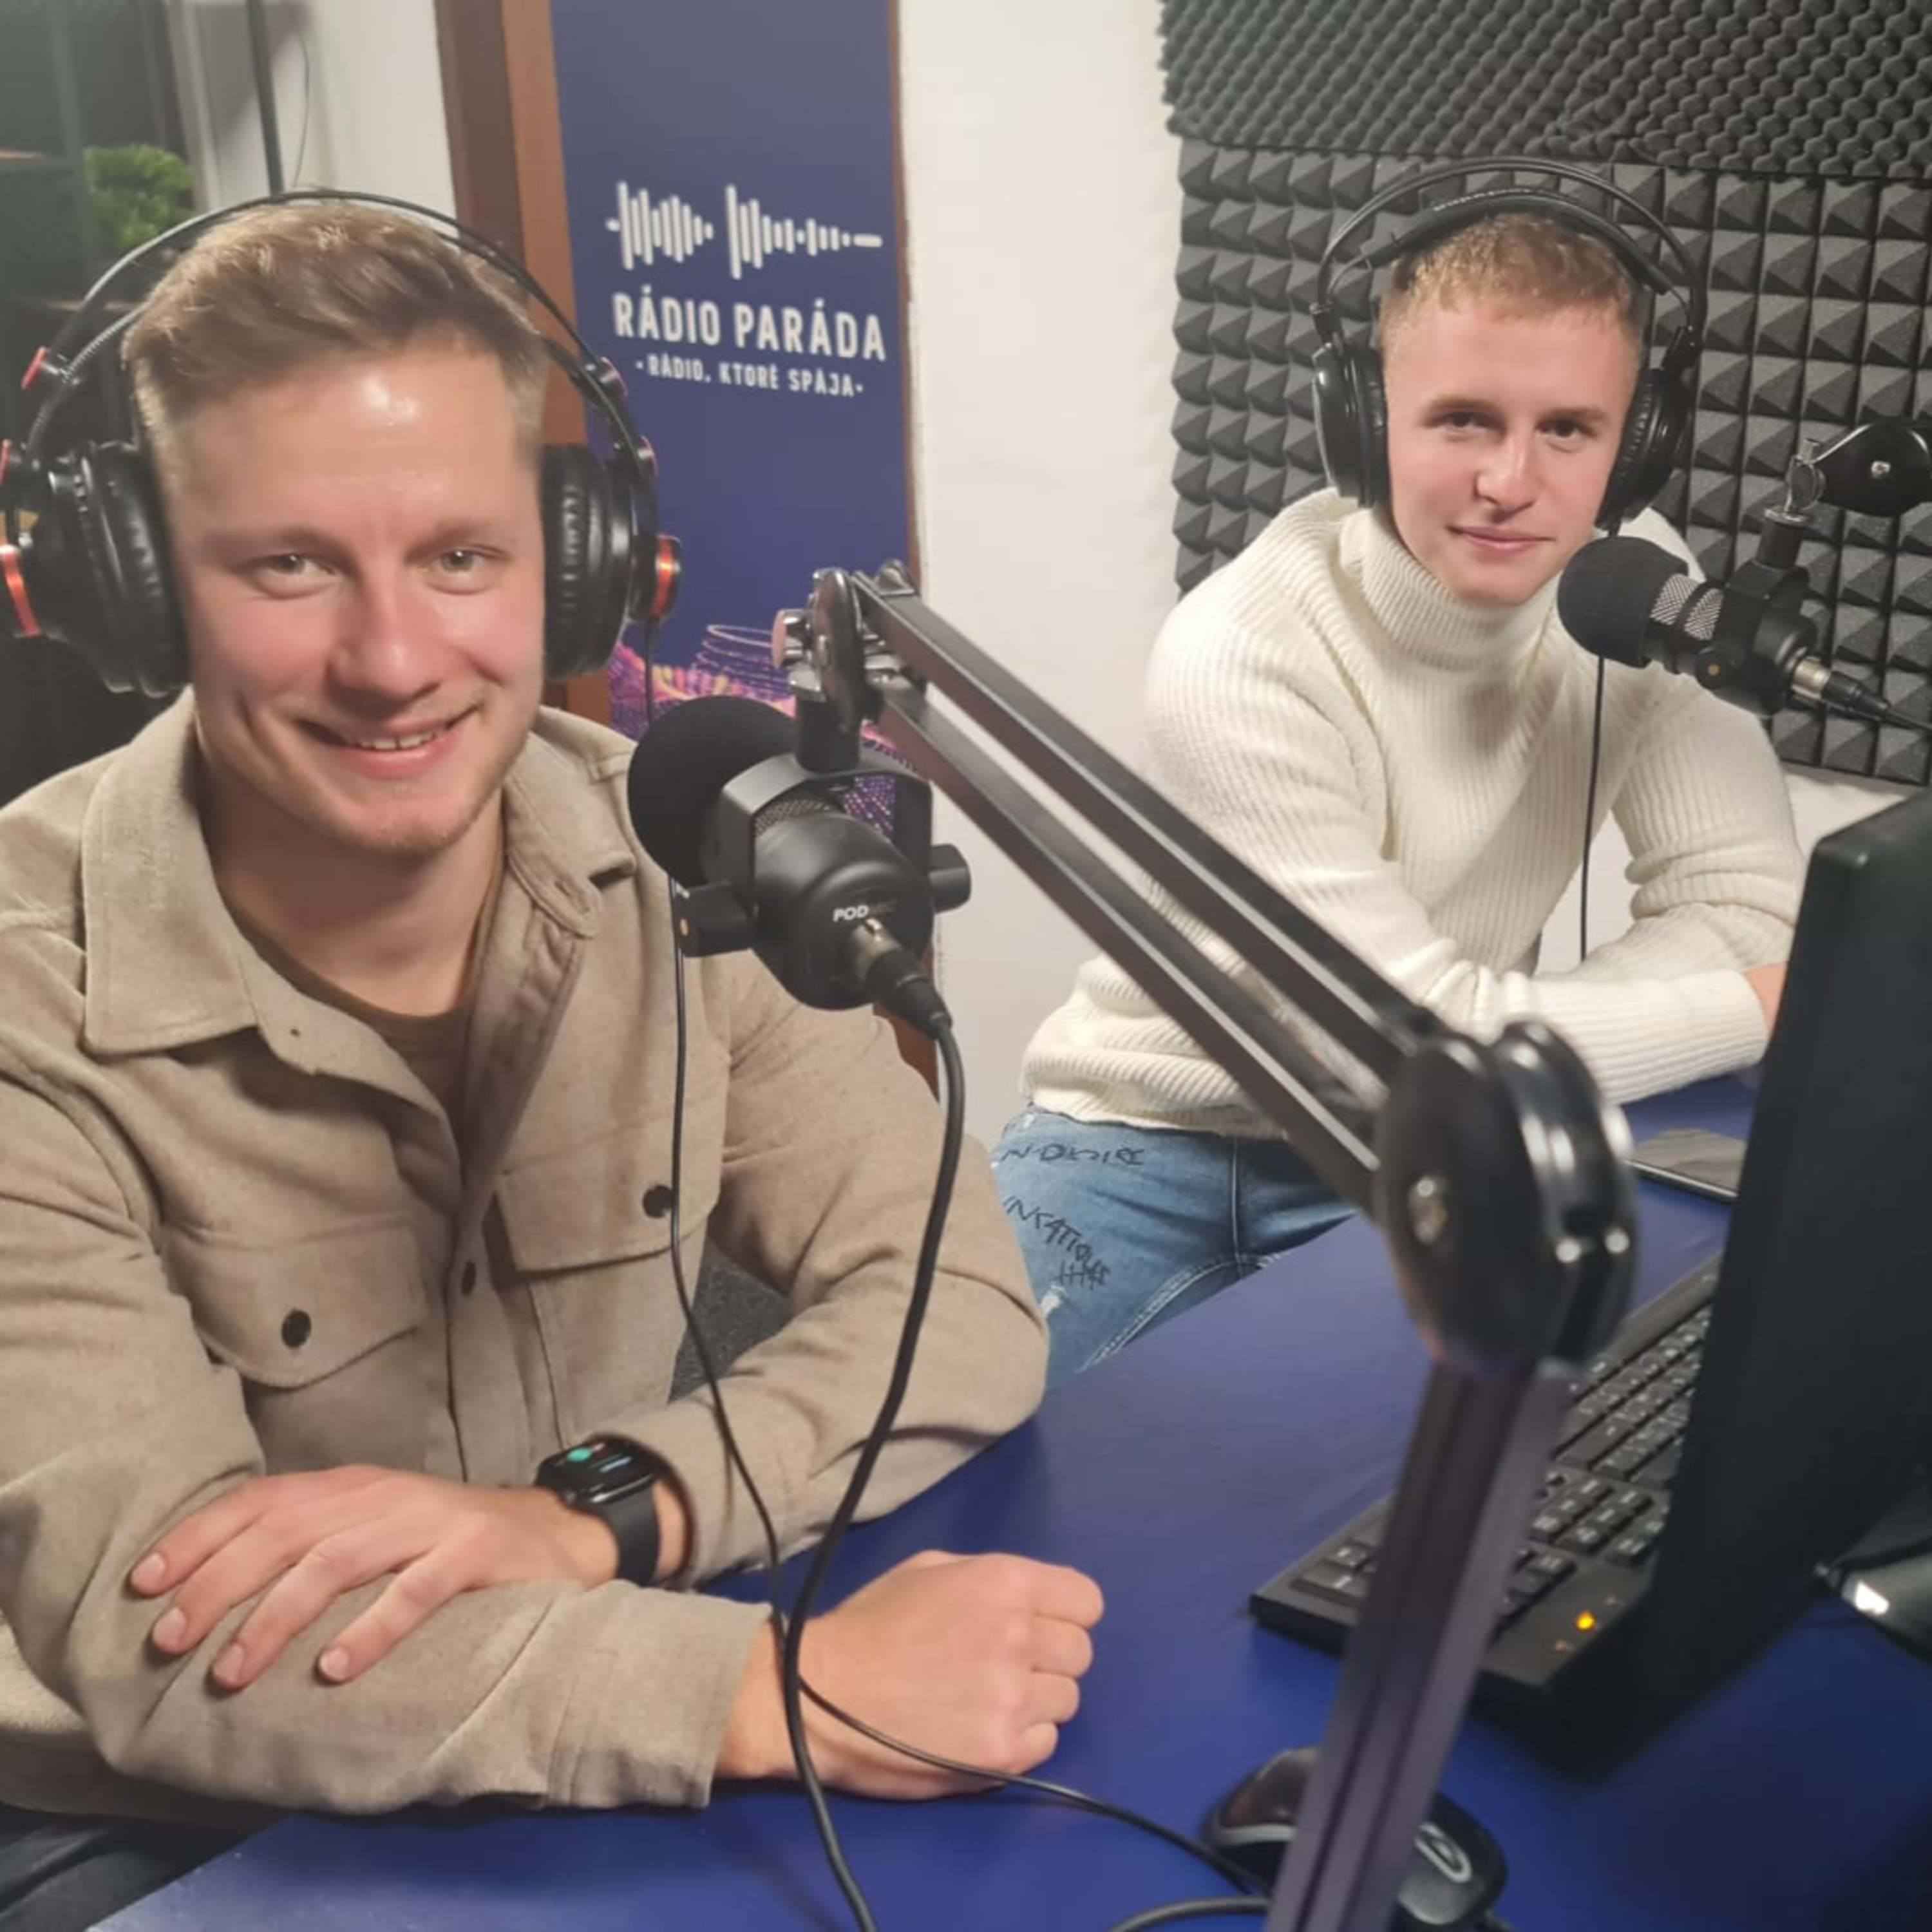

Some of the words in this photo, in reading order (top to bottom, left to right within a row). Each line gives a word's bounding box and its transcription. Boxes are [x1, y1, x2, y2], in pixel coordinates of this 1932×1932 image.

[613, 284, 721, 346] RÁDIO
[733, 298, 886, 361] PARÁDA
[719, 361, 780, 390] KTORÉ
